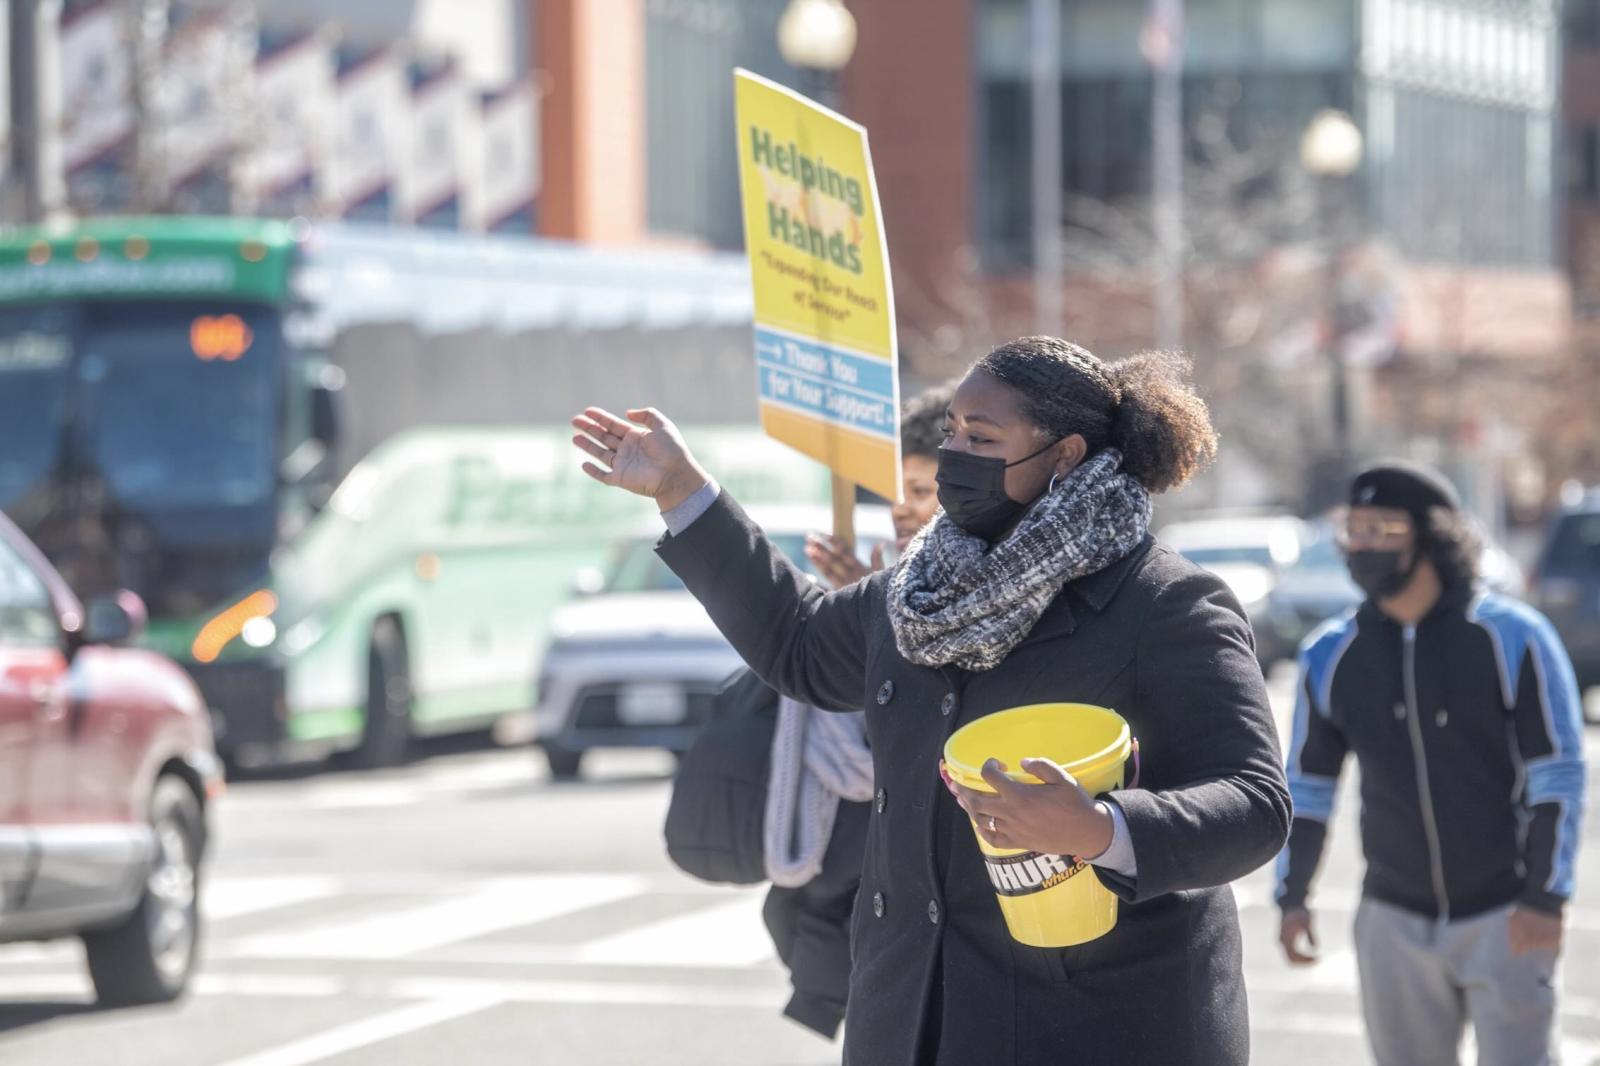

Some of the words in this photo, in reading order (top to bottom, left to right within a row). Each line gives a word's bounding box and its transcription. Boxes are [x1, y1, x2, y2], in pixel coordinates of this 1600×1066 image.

[751, 126, 863, 215] Helping
[769, 201, 862, 274] Hands
[785, 343, 828, 376] Thank
[831, 355, 858, 385] You
[768, 369, 792, 401] for
[792, 377, 822, 405] Your
[1041, 860, 1087, 889] whur.c
